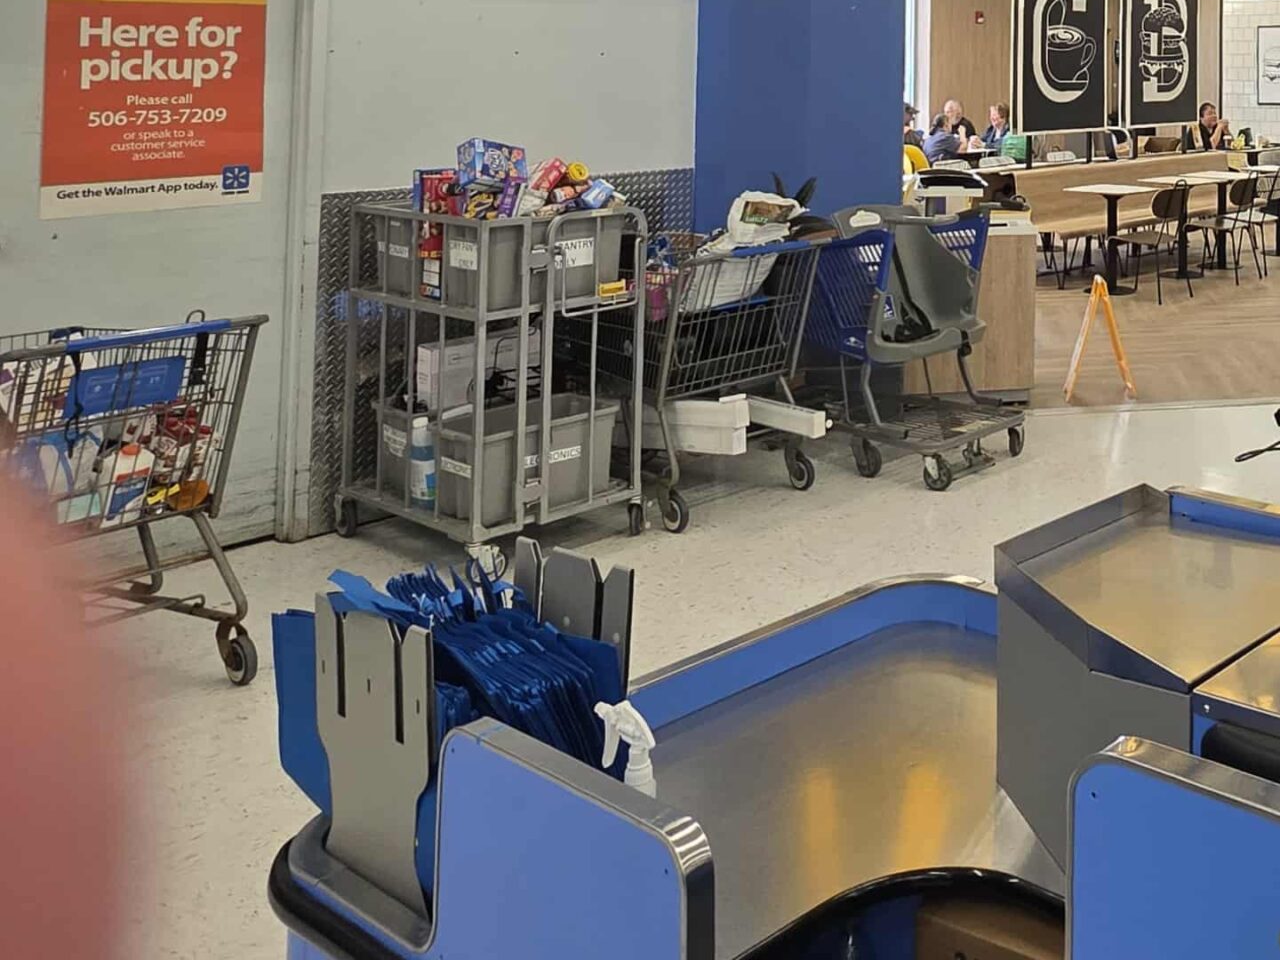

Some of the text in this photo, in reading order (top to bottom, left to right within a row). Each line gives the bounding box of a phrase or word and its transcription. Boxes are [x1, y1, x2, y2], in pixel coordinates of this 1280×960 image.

[79, 16, 242, 48] Here for
[80, 50, 239, 90] pickup?
[126, 93, 193, 106] Please call
[87, 107, 227, 128] 506-753-7209
[110, 139, 206, 152] customer service
[123, 129, 194, 142] or speak to a
[56, 180, 219, 200] Get the Walmart App today.
